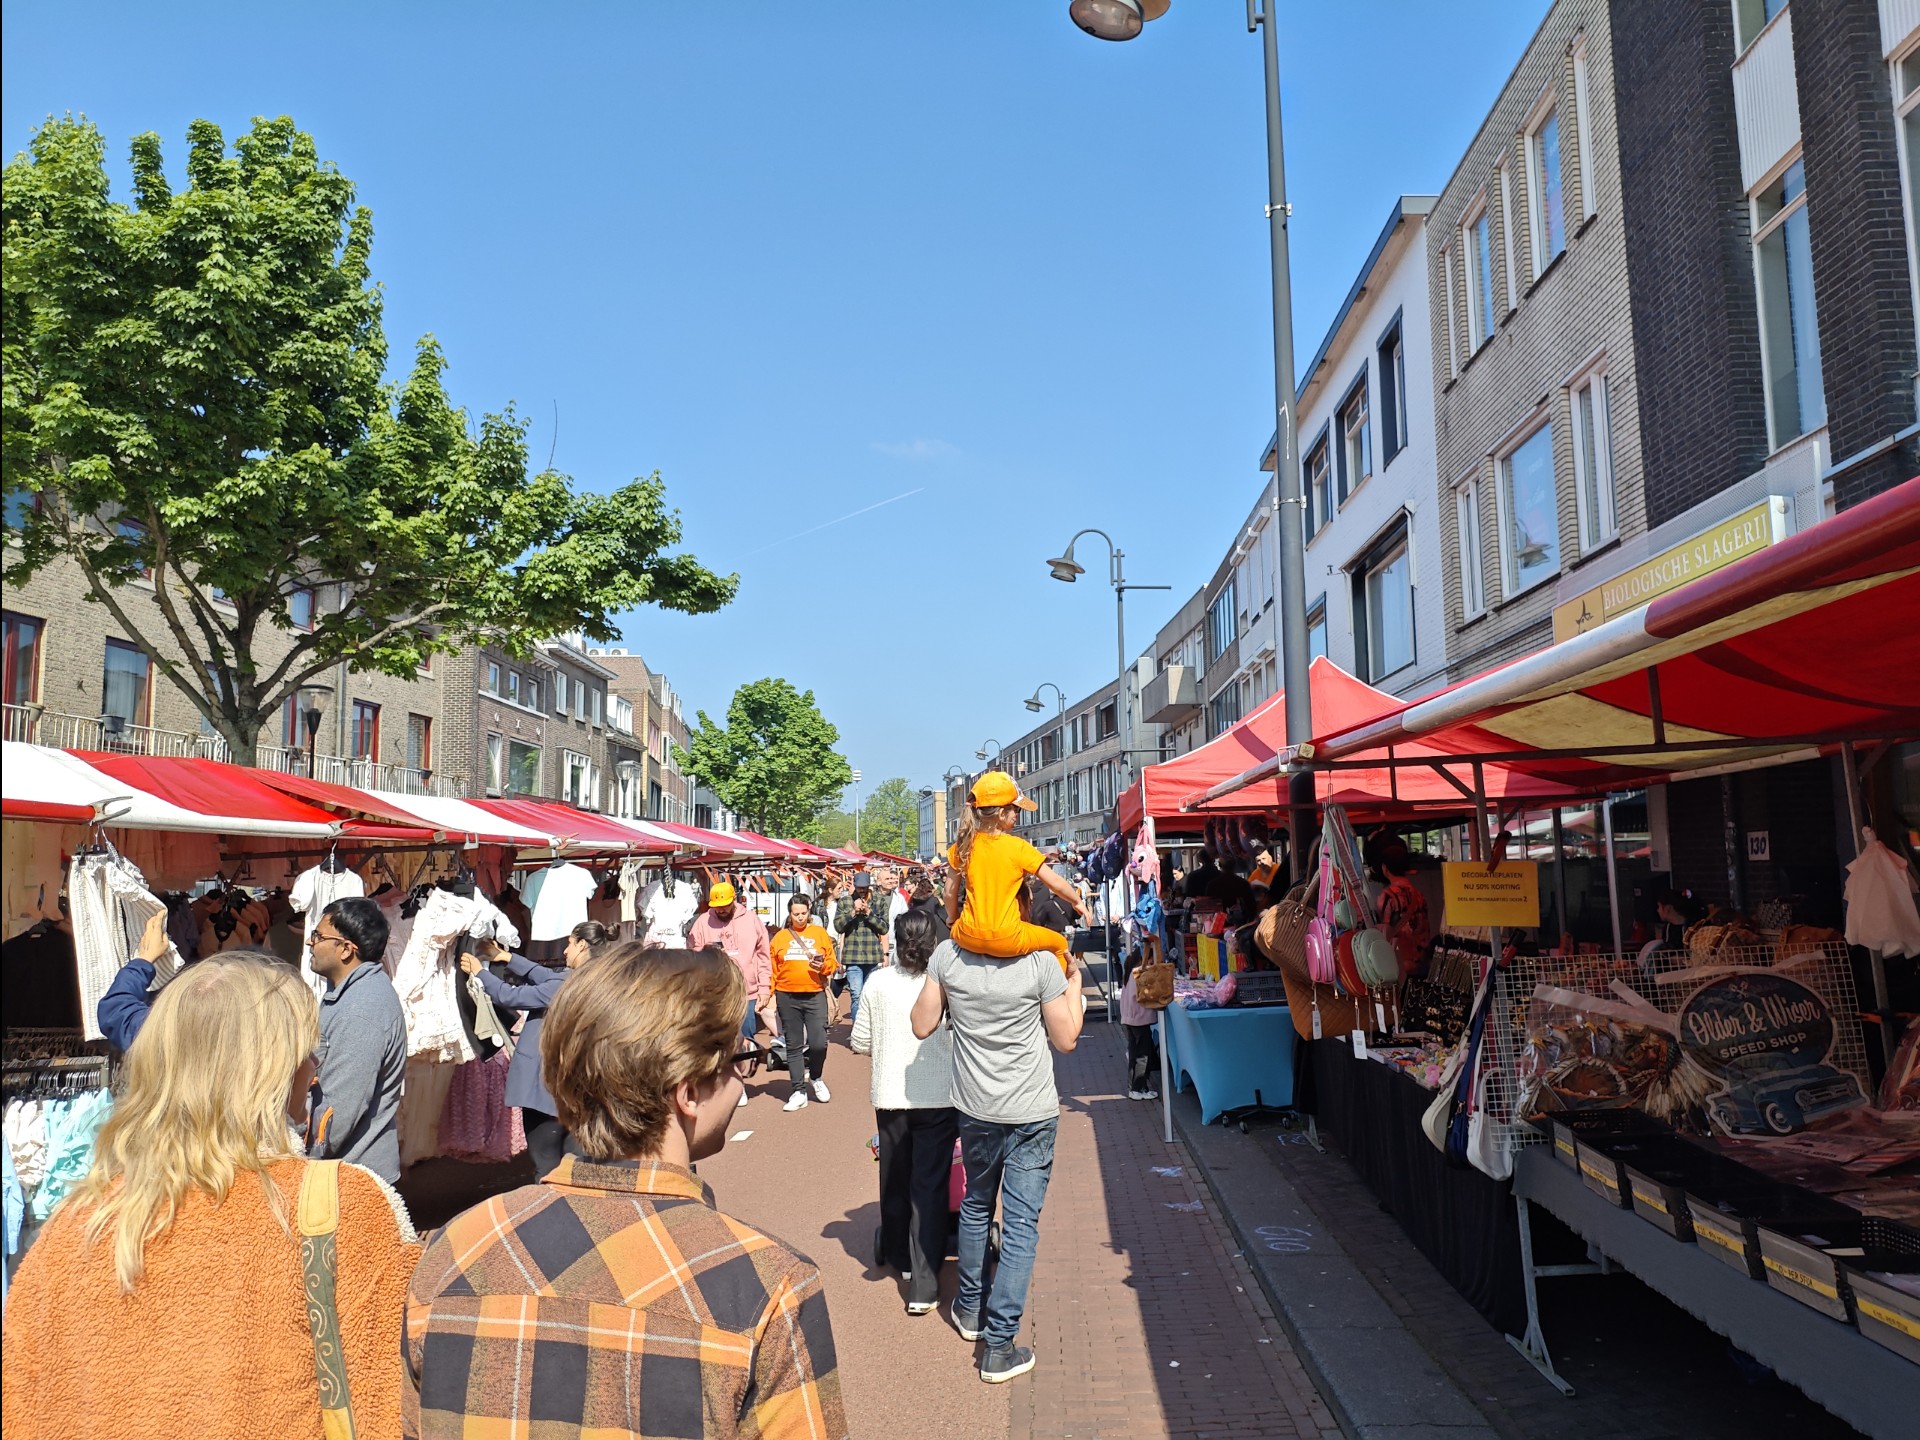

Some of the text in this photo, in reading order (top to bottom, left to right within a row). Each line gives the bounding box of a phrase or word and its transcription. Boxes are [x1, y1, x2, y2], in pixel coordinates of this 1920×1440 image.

[1603, 513, 1767, 610] BIOLOGISCHE SLAGERIJ
[1750, 836, 1767, 855] 130
[1461, 871, 1523, 879] DECORATIEPLATEN
[1688, 993, 1821, 1046] Older & Wiser
[1720, 1032, 1808, 1059] SPEED SHOP
